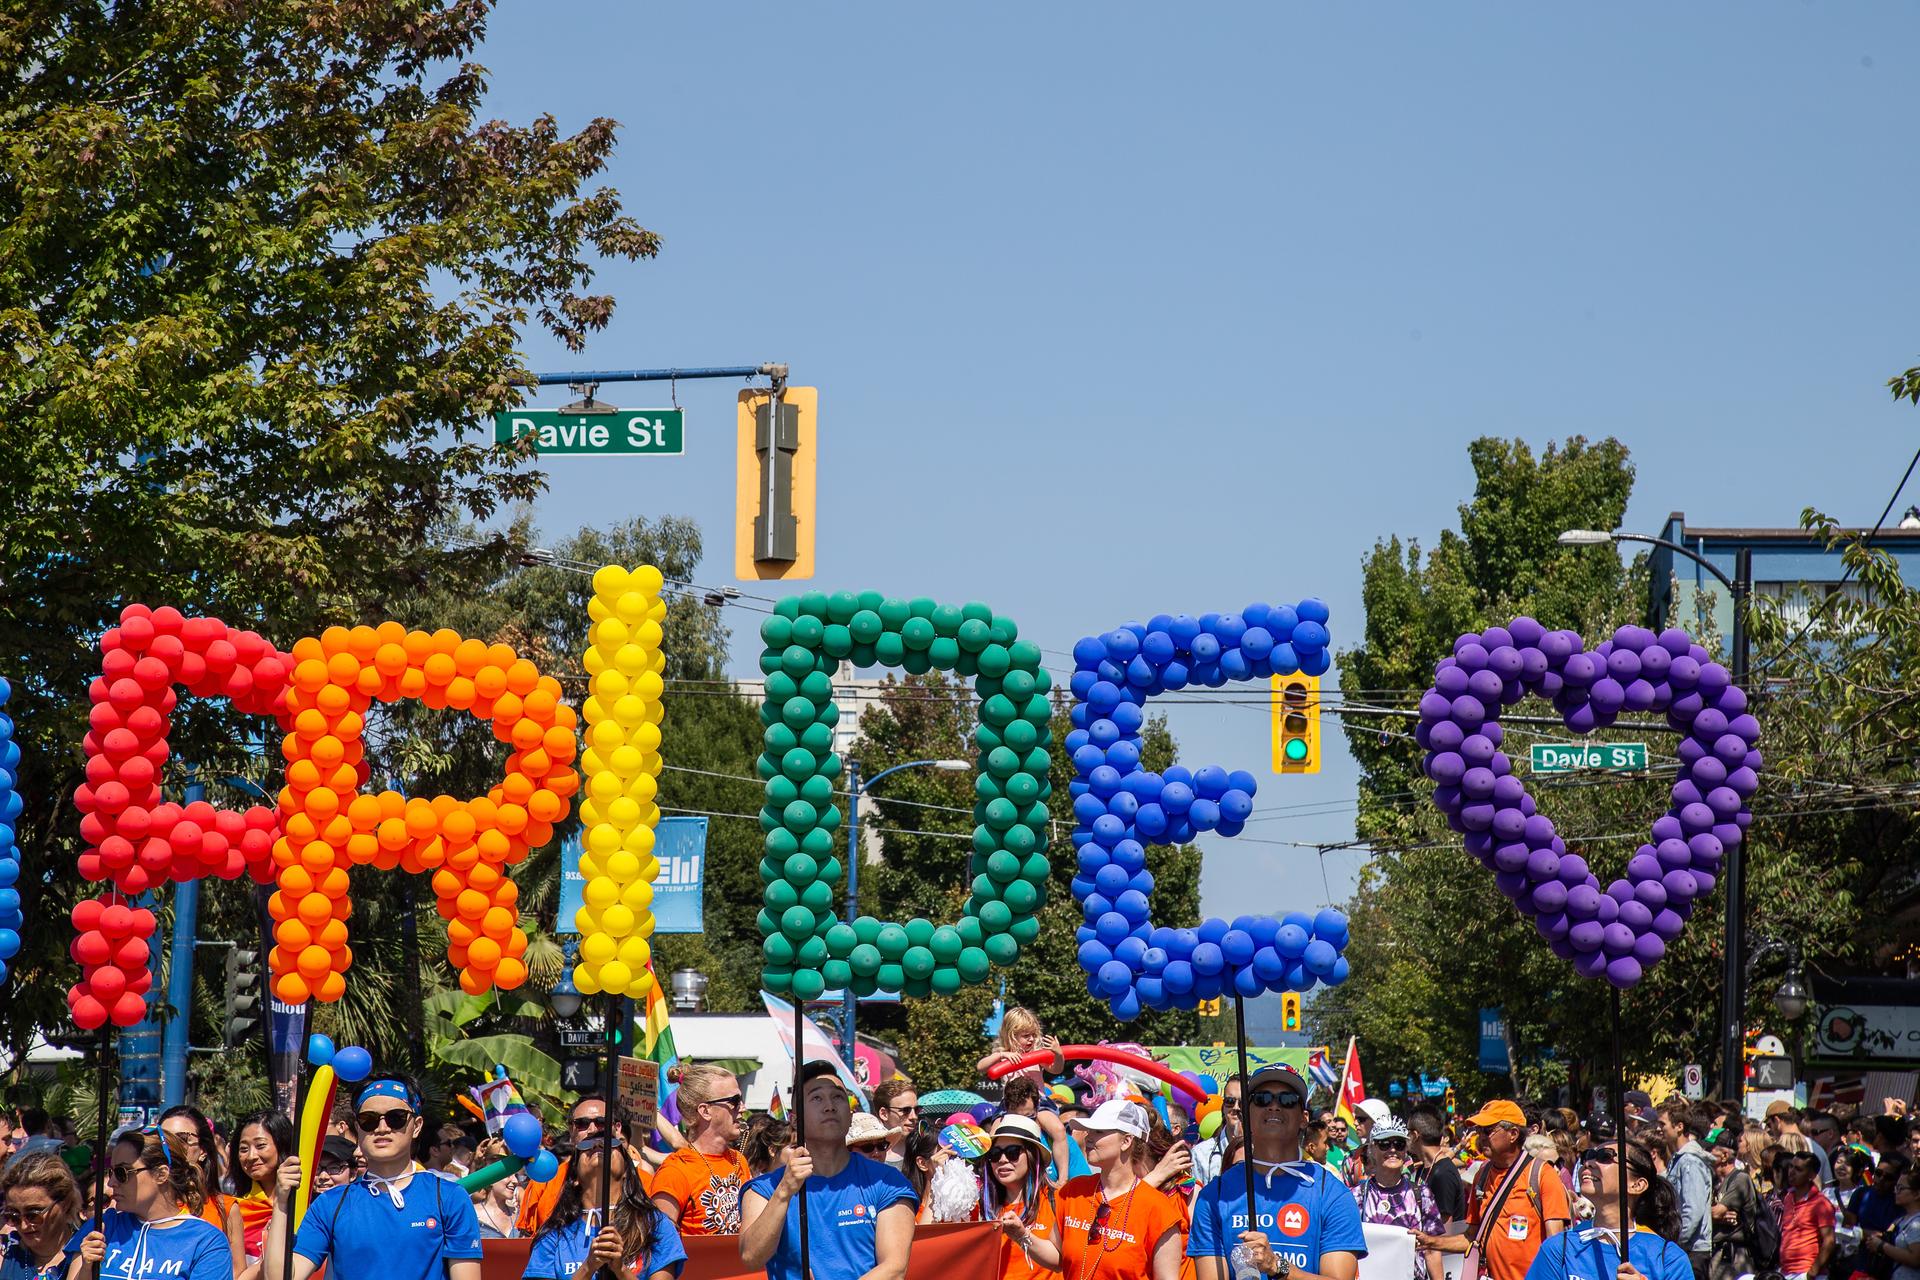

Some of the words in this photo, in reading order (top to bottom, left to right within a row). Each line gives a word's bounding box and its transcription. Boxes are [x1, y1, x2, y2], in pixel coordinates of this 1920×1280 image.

[512, 418, 609, 447] Davie
[627, 417, 666, 447] St
[1612, 748, 1636, 767] St
[567, 1033, 589, 1043] DAVIE
[105, 1249, 183, 1276] TEAM
